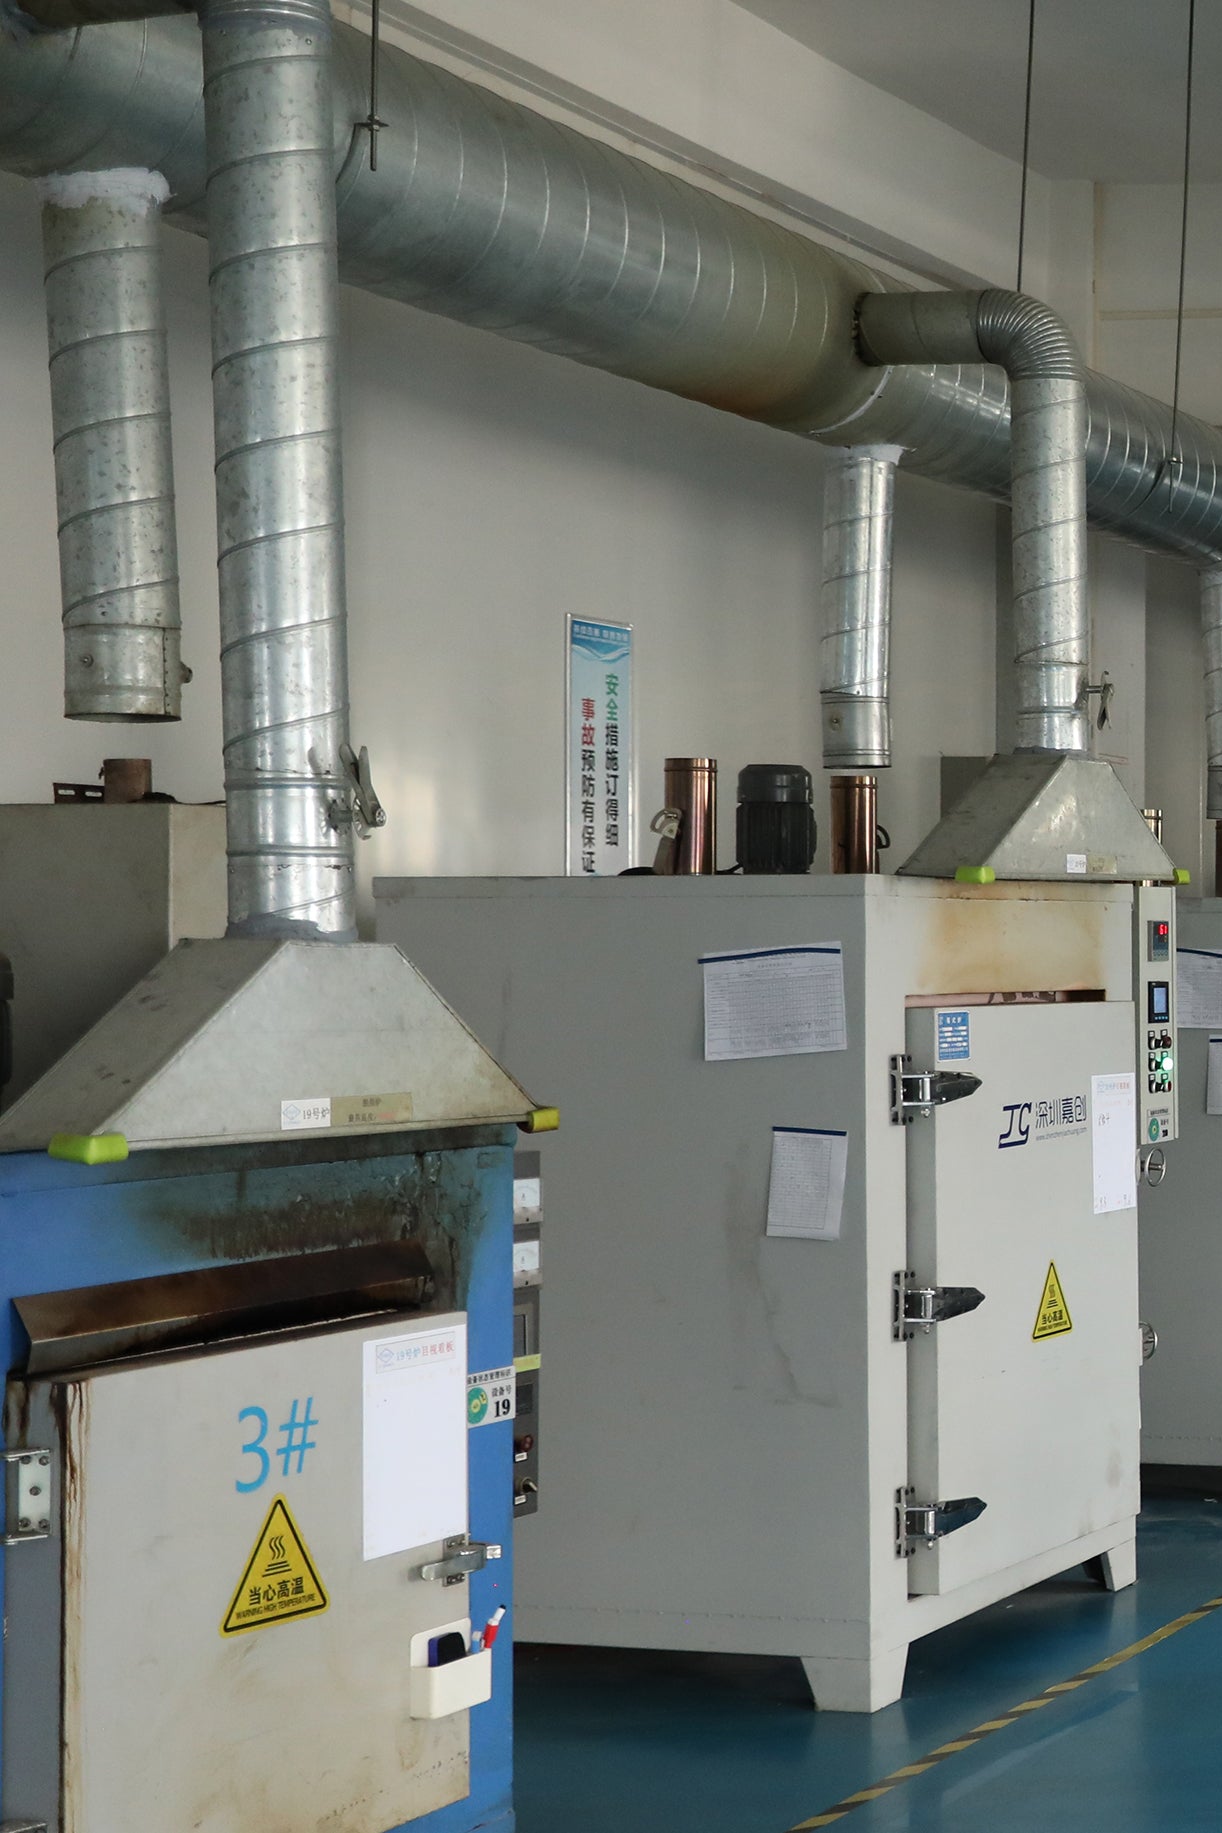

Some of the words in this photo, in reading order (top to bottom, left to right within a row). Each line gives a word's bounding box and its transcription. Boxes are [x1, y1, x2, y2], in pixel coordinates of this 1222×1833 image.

[581, 697, 596, 874] 事故预防有保证
[1035, 1094, 1087, 1129] 深圳嘉创
[492, 1384, 512, 1397] 设备号
[494, 1398, 511, 1418] 19
[235, 1396, 319, 1495] 3#
[249, 1576, 304, 1606] 当心高温
